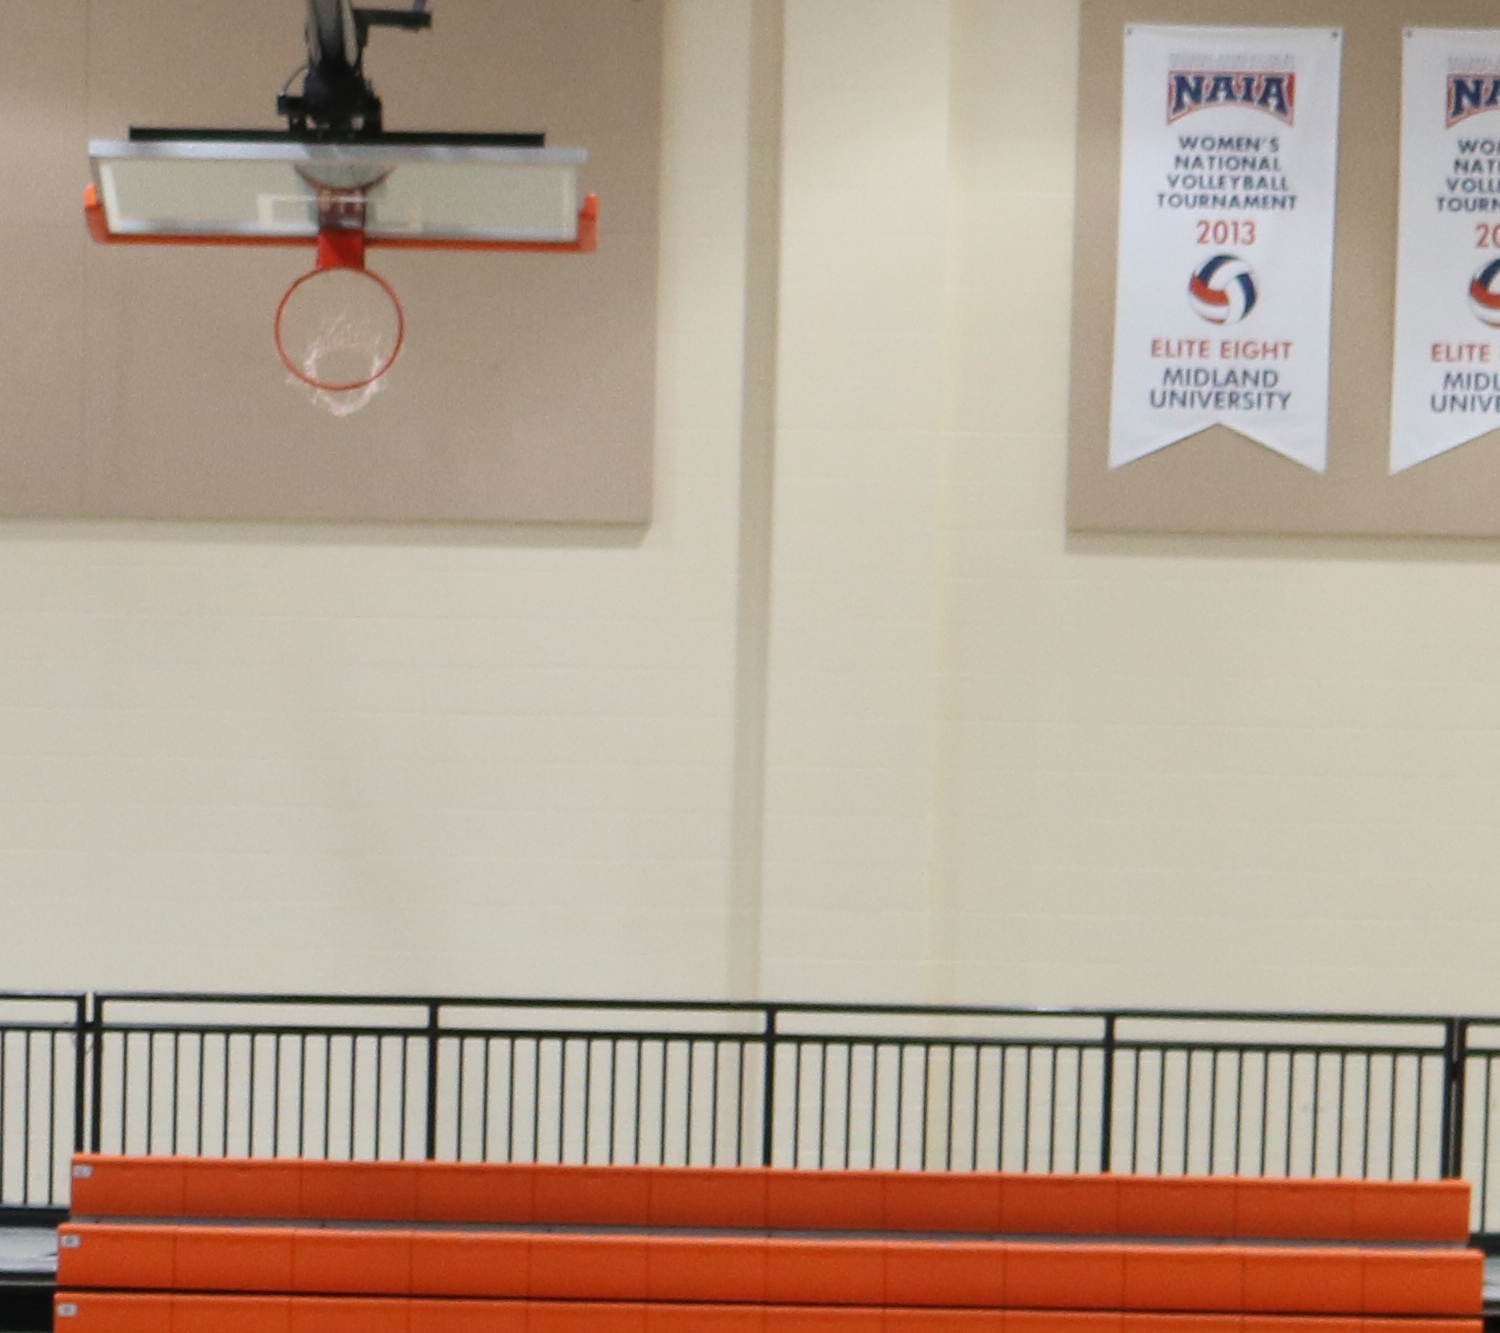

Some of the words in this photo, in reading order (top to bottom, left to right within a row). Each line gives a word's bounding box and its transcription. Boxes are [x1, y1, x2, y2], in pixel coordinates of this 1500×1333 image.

[1171, 75, 1289, 116] NAIA
[1178, 136, 1280, 153] WOMEN'S
[1173, 155, 1281, 172] NATIONAL
[1166, 174, 1289, 191] VOLLEYBALL
[1156, 193, 1297, 211] TOURNAMENT
[1196, 219, 1257, 245] 2013
[1150, 338, 1211, 359] ELITE
[1219, 339, 1293, 361] EIGHT
[1430, 343, 1491, 364] ELITE
[1162, 367, 1278, 388] MIDLAND
[1150, 390, 1293, 412] UNIVERSITY
